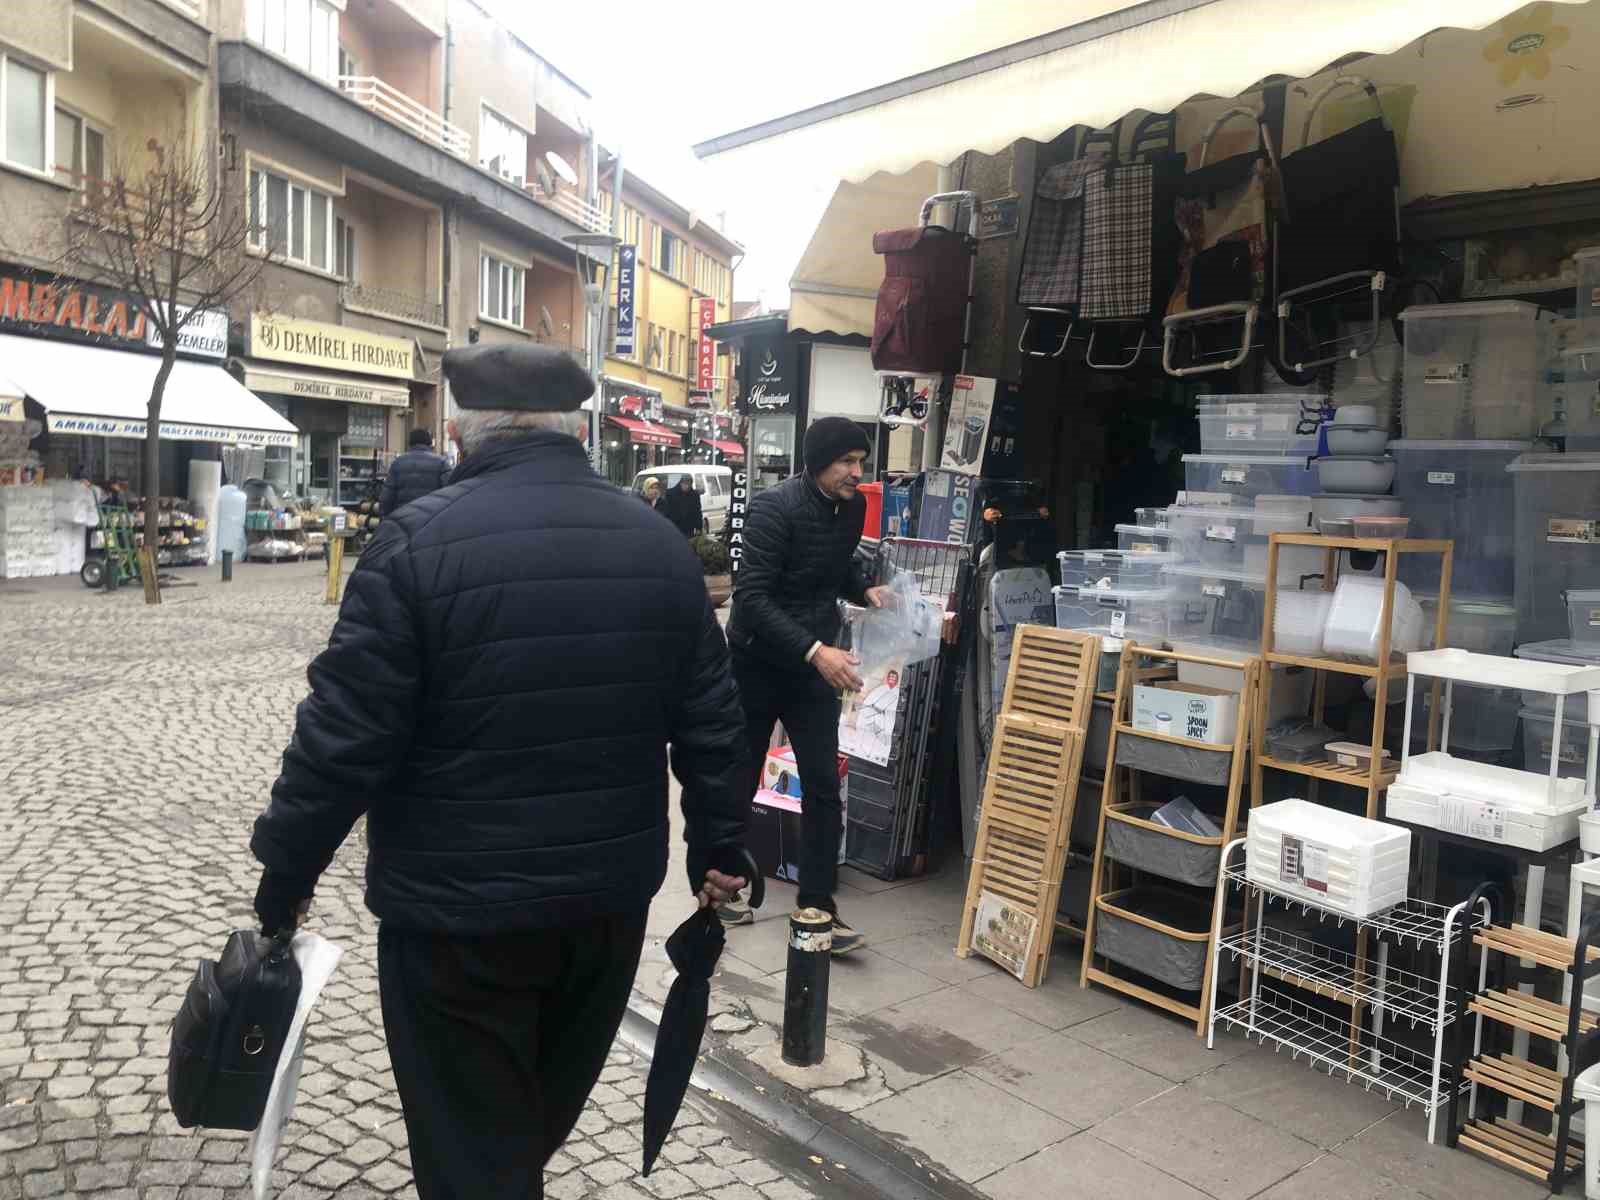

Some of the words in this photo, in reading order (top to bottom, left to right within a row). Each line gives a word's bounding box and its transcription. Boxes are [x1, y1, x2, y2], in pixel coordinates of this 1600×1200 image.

[620, 269, 631, 322] ERK
[284, 330, 349, 361] DEMİREL
[352, 343, 409, 370] HIRDAVAT
